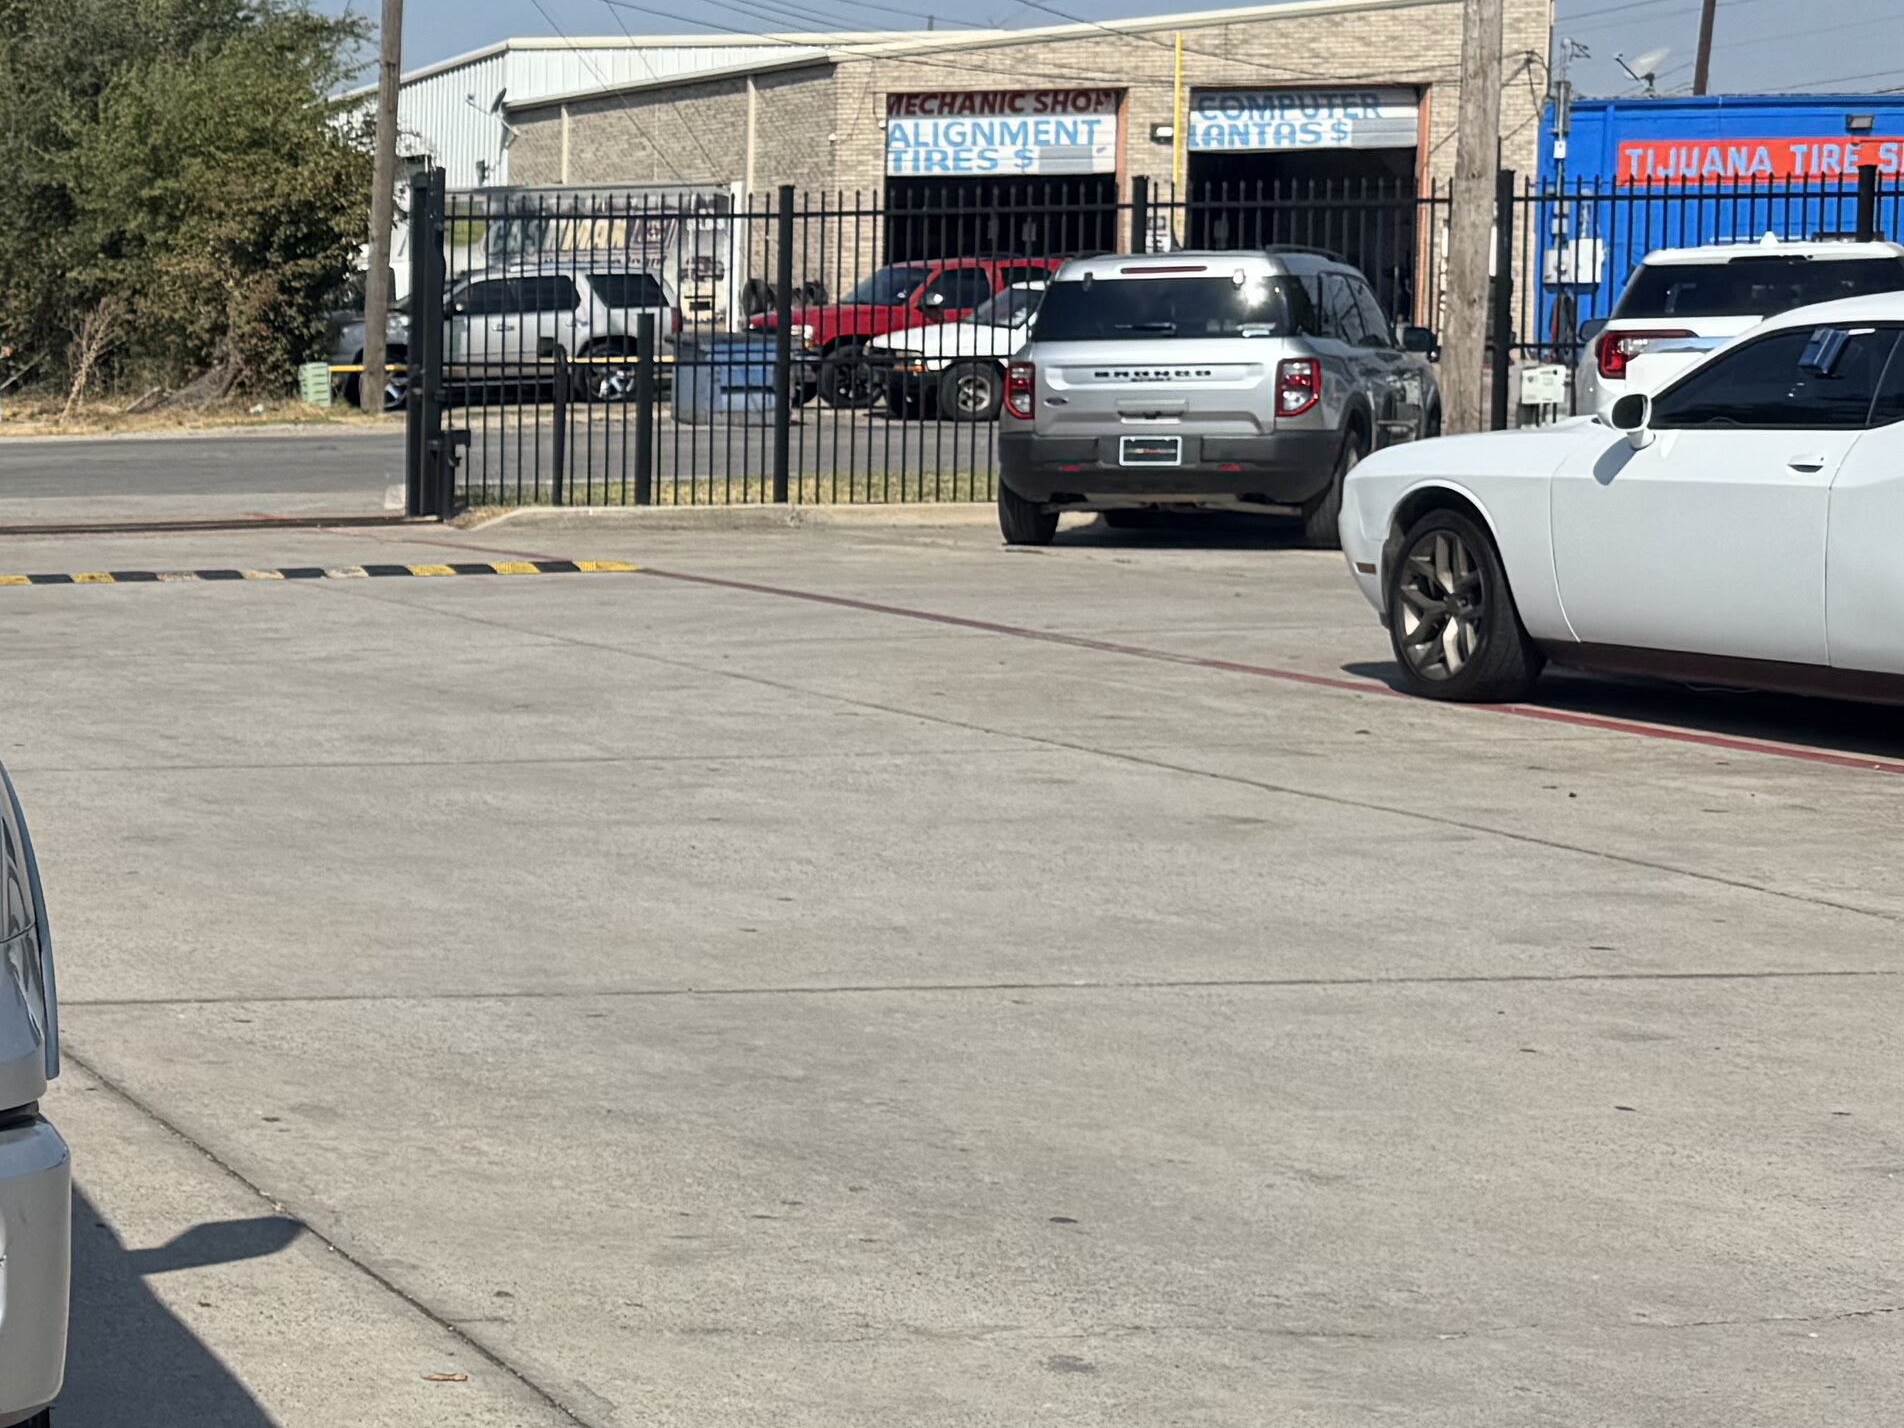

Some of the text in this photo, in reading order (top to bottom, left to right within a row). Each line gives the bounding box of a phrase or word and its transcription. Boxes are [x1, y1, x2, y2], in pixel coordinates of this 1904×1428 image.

[1198, 93, 1384, 121] COMPUTER
[888, 119, 1102, 149] ALIGNMENT
[888, 147, 1000, 173] TIRES
[1625, 145, 1774, 179] TIJUANA
[1789, 144, 1863, 174] TIRE
